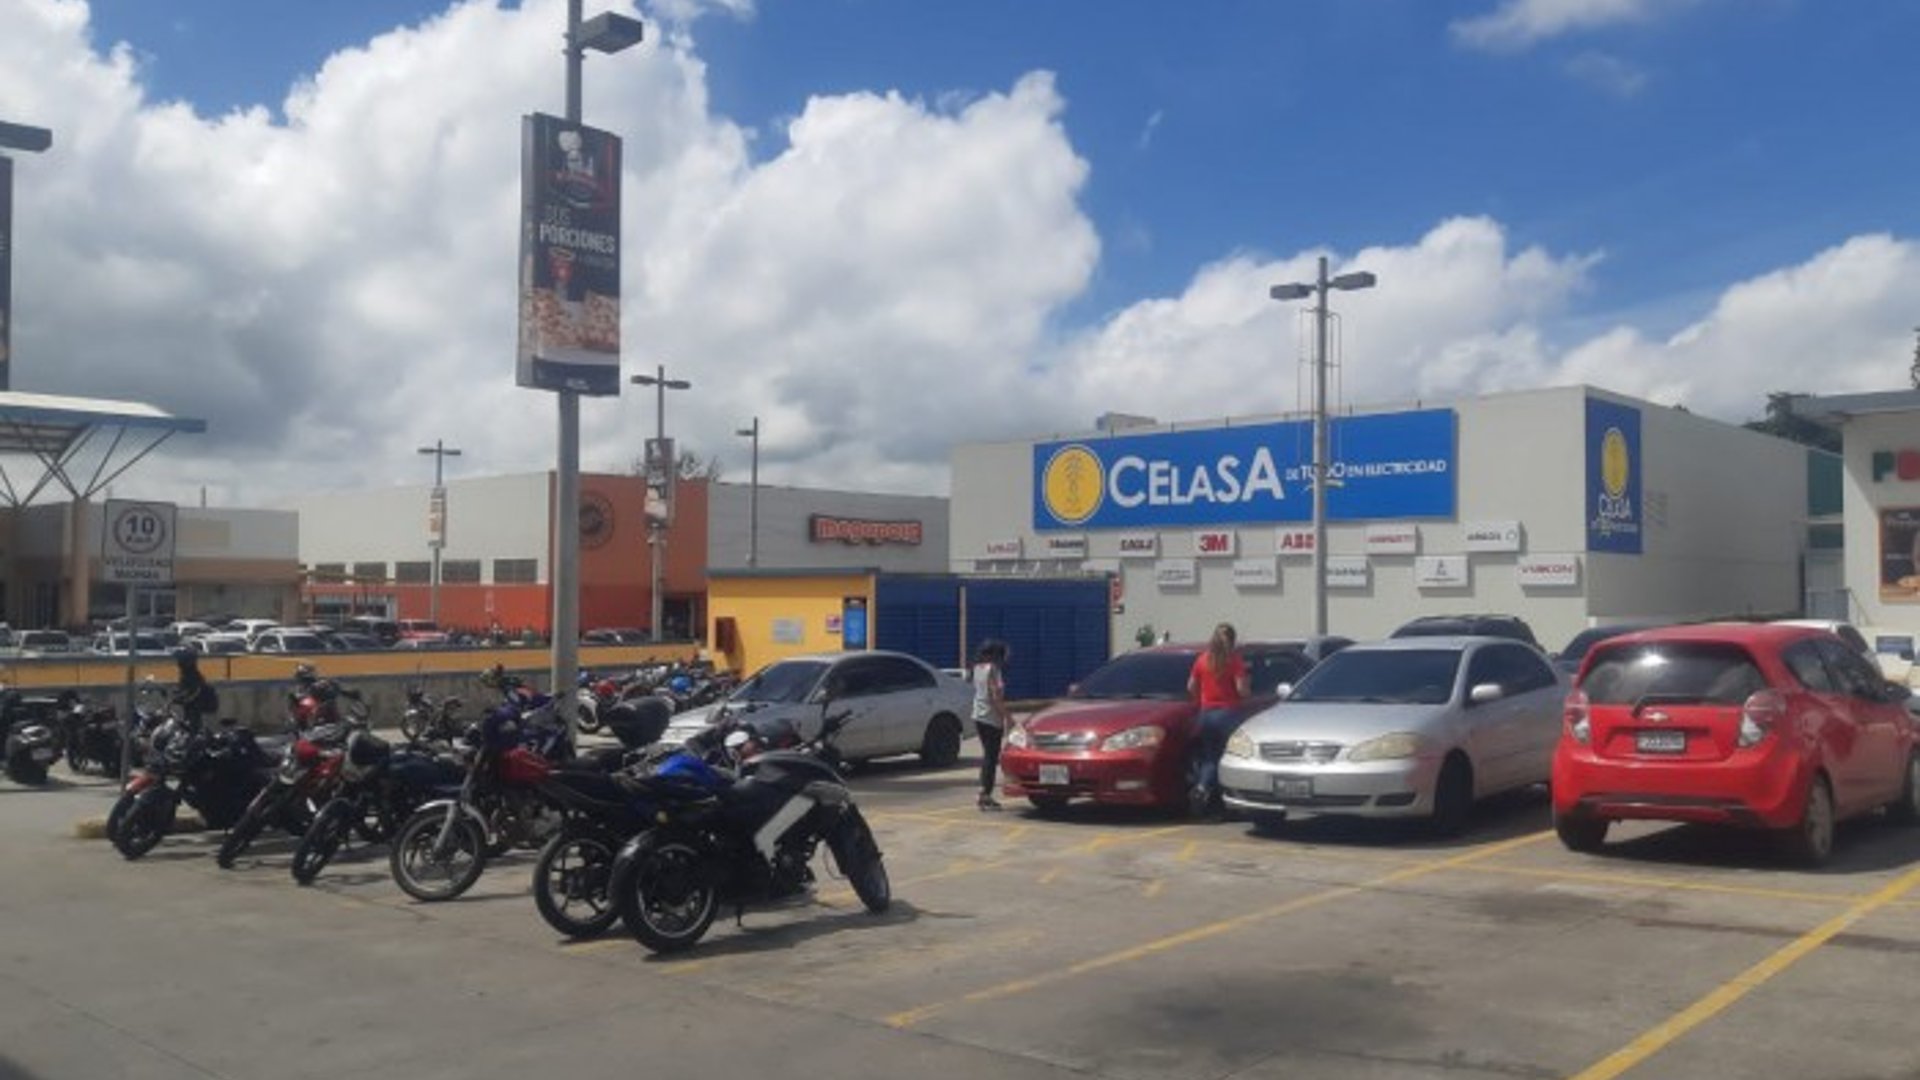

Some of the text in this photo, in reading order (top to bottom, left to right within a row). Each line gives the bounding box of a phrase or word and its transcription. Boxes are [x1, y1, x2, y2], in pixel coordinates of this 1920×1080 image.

[540, 223, 615, 254] PORCIONES
[1109, 446, 1285, 508] CELASA
[126, 515, 155, 536] 10
[1199, 533, 1229, 552] 3M
[1281, 532, 1315, 549] ABB
